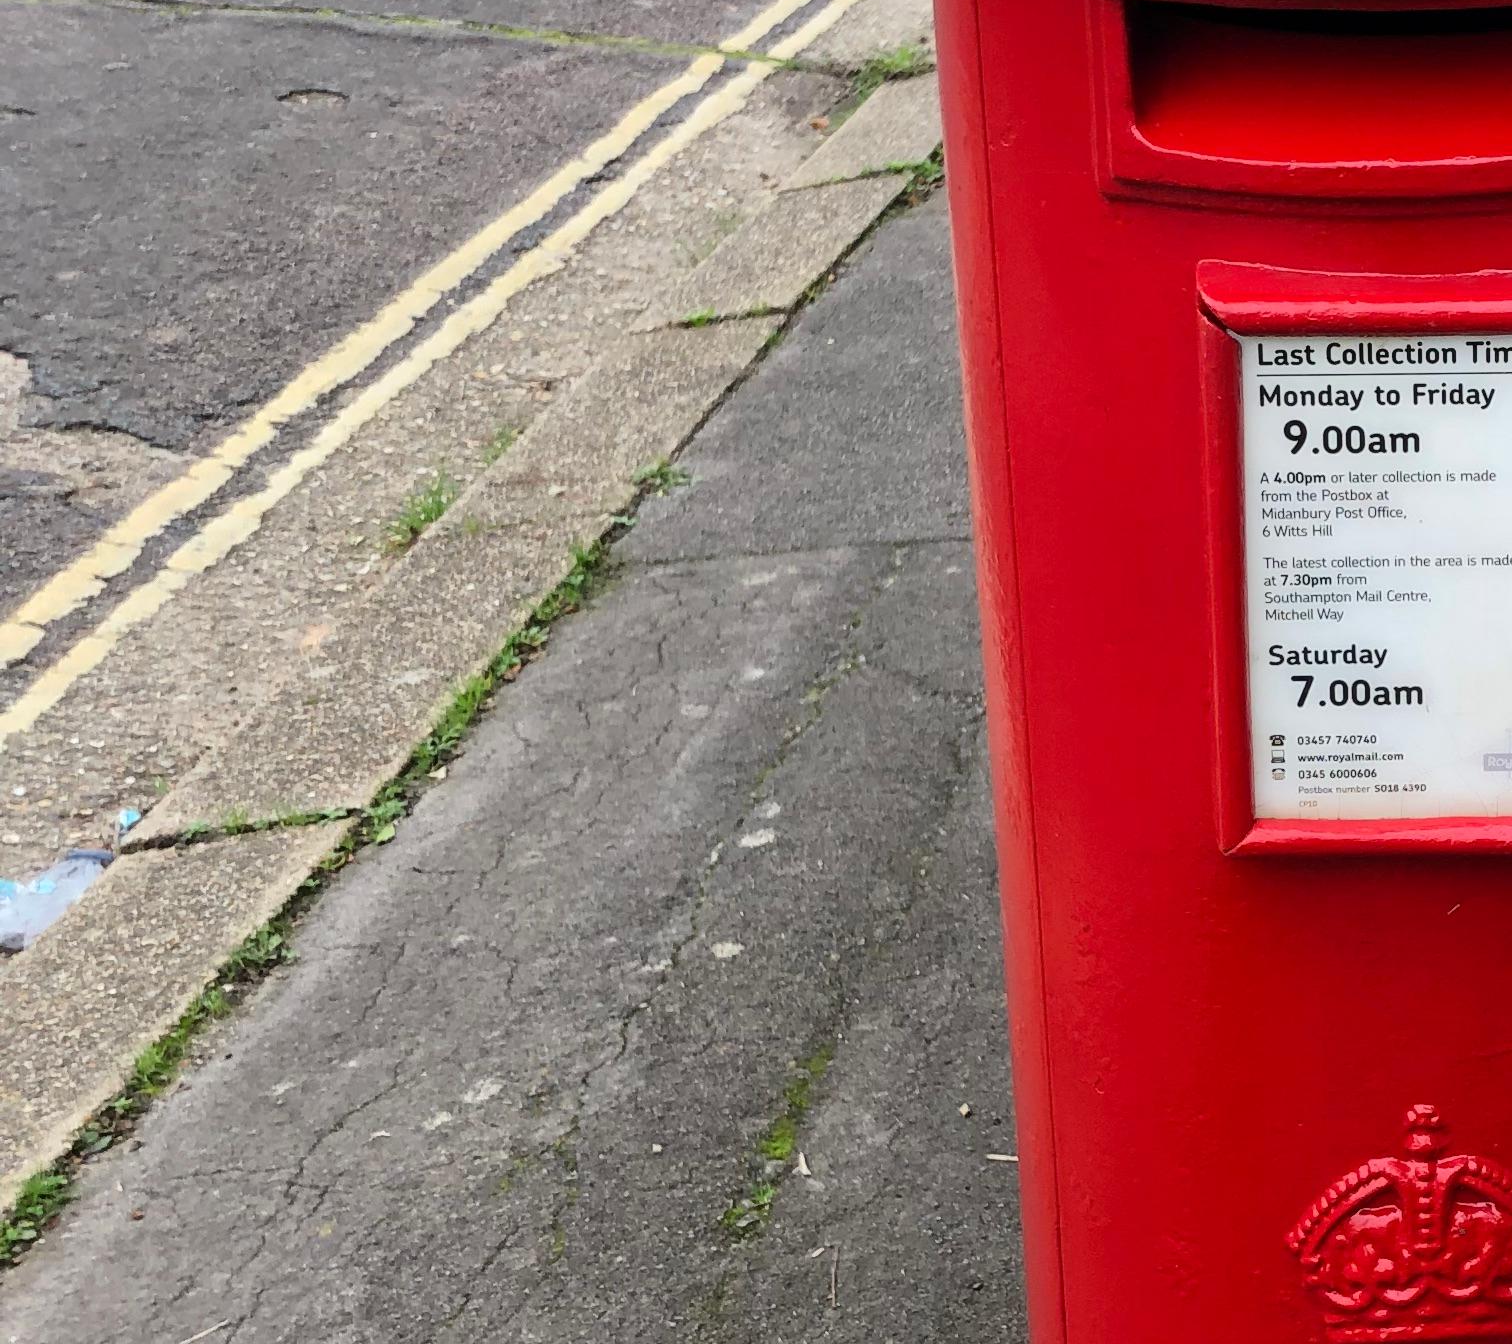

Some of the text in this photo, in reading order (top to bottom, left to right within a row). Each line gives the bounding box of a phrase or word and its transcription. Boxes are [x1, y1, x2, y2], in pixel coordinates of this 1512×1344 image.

[1258, 343, 1315, 365] Last
[1326, 341, 1456, 365] Collection
[1260, 383, 1495, 411] Monday to Friday
[1284, 420, 1419, 454] 9.00am
[1260, 470, 1497, 487] A 4.00pm or later collection is made
[1261, 489, 1389, 502] from the Postbox at
[1262, 506, 1407, 522] Midanbury Post Office,
[1263, 525, 1333, 538] 6 Witts Hill
[1263, 557, 1288, 569] The
[1293, 557, 1328, 569] latest
[1331, 556, 1390, 568] collection
[1395, 556, 1406, 567] in
[1410, 556, 1431, 567] the
[1435, 558, 1463, 567] area
[1467, 556, 1477, 567] is
[1264, 574, 1367, 588] at 7.30pm from
[1265, 590, 1432, 605] Southampton Mail Centre,
[1266, 608, 1344, 623] Mitchell Way
[1269, 644, 1387, 668] Saturday
[1291, 676, 1422, 707] 7.00am
[1298, 735, 1377, 746] 03457 740740
[1298, 753, 1404, 764] www.royalmail.com
[1299, 769, 1378, 780] 0345 6000606
[1299, 786, 1333, 794] Postbox
[1336, 786, 1371, 794] number
